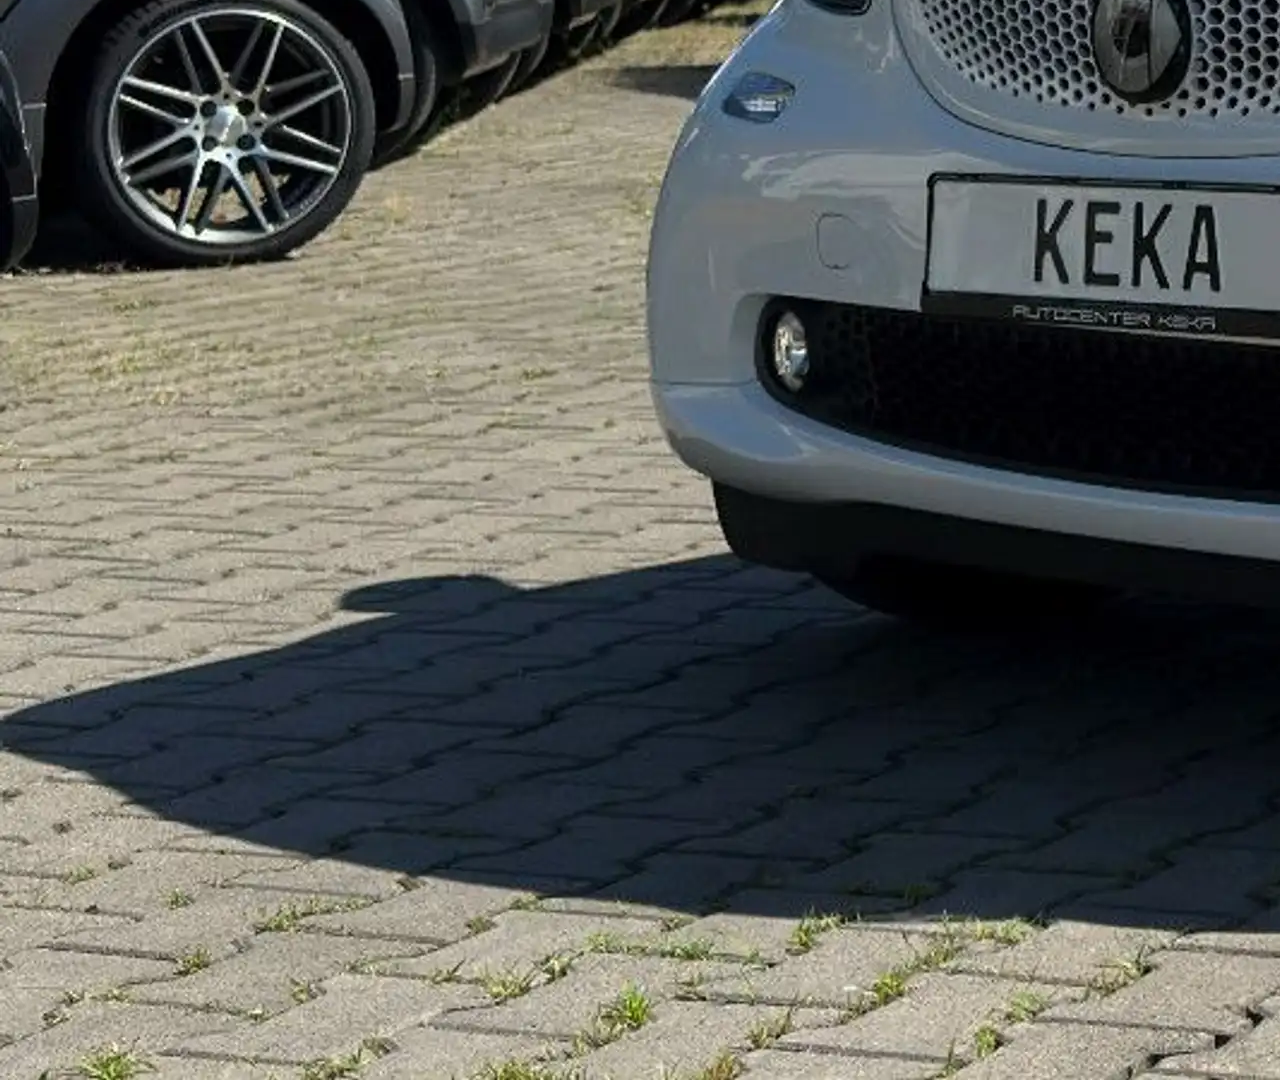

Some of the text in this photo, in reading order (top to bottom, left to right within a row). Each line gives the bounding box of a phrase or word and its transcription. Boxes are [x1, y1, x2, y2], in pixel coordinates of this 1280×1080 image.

[1033, 198, 1222, 293] KEKA
[1012, 304, 1216, 331] AUTOCENTER KEKA
